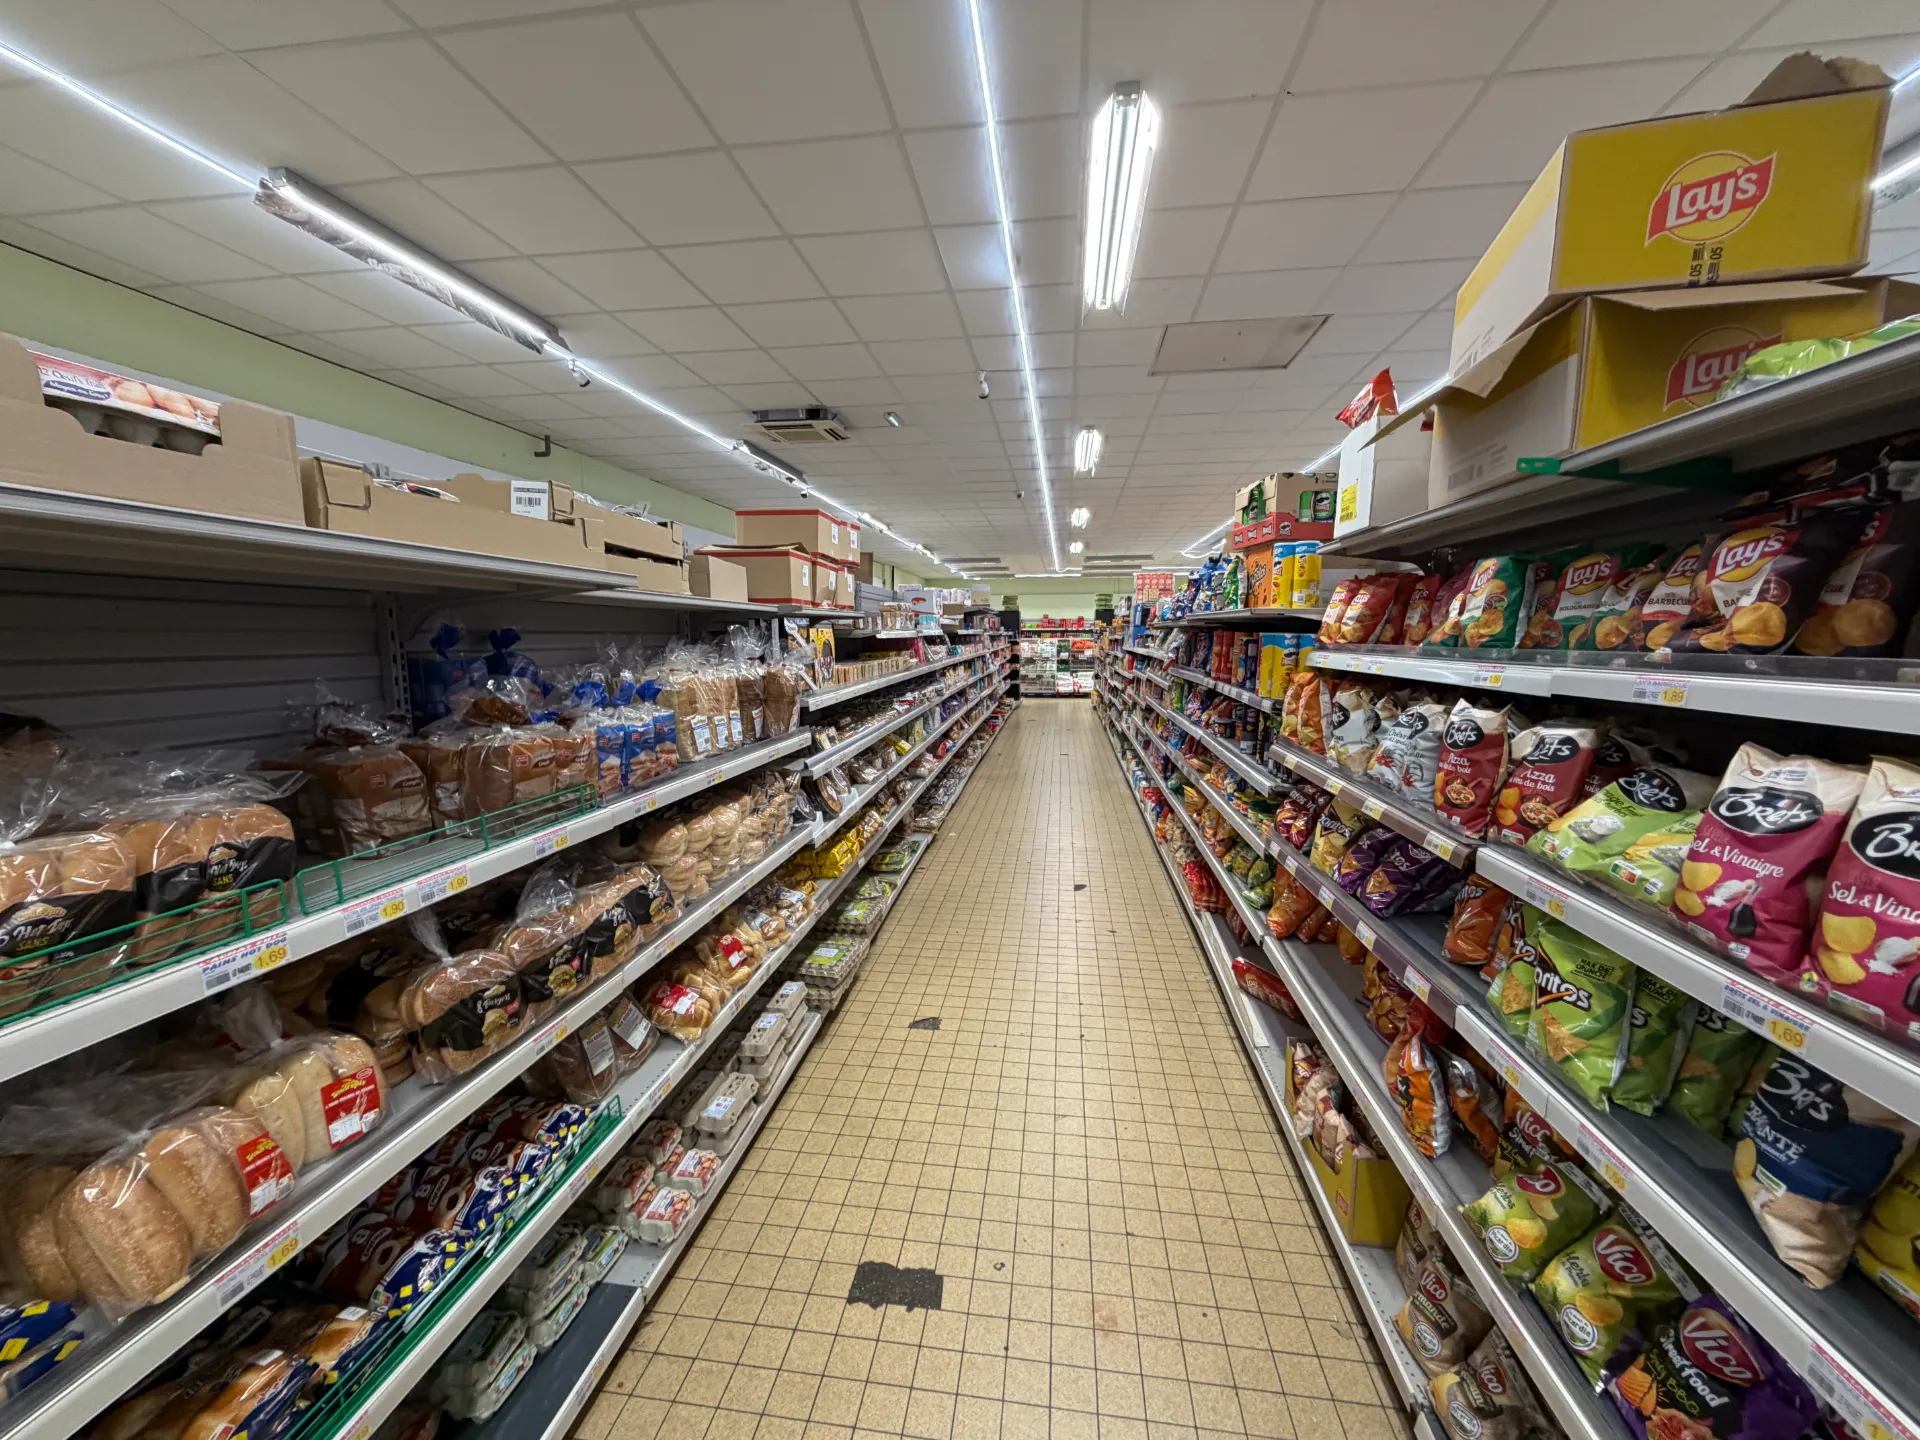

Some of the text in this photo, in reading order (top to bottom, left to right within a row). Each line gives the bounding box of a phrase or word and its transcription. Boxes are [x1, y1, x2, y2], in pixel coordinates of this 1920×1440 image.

[1666, 167, 1758, 229] Lay's
[1715, 533, 1785, 577] Lay's
[1565, 559, 1612, 590] Lay's
[1718, 792, 1814, 829] Brets
[1710, 845, 1722, 857] &
[1722, 845, 1785, 878] Vinaigre
[212, 873, 234, 886] SANS
[449, 876, 468, 890] 1,90
[1829, 881, 1858, 905] Sel
[1858, 894, 1872, 908] &
[382, 900, 405, 918] 1,90
[13, 925, 47, 941] Hot
[202, 936, 288, 973] PAINS HOT DOG
[257, 948, 287, 968] 1,69
[476, 998, 484, 1014] 8
[1770, 1020, 1804, 1048] 1,69
[270, 1237, 298, 1266] 1,69
[1596, 1233, 1647, 1283] Vico
[1420, 1270, 1447, 1301] Vico
[1683, 1316, 1753, 1379] Vico
